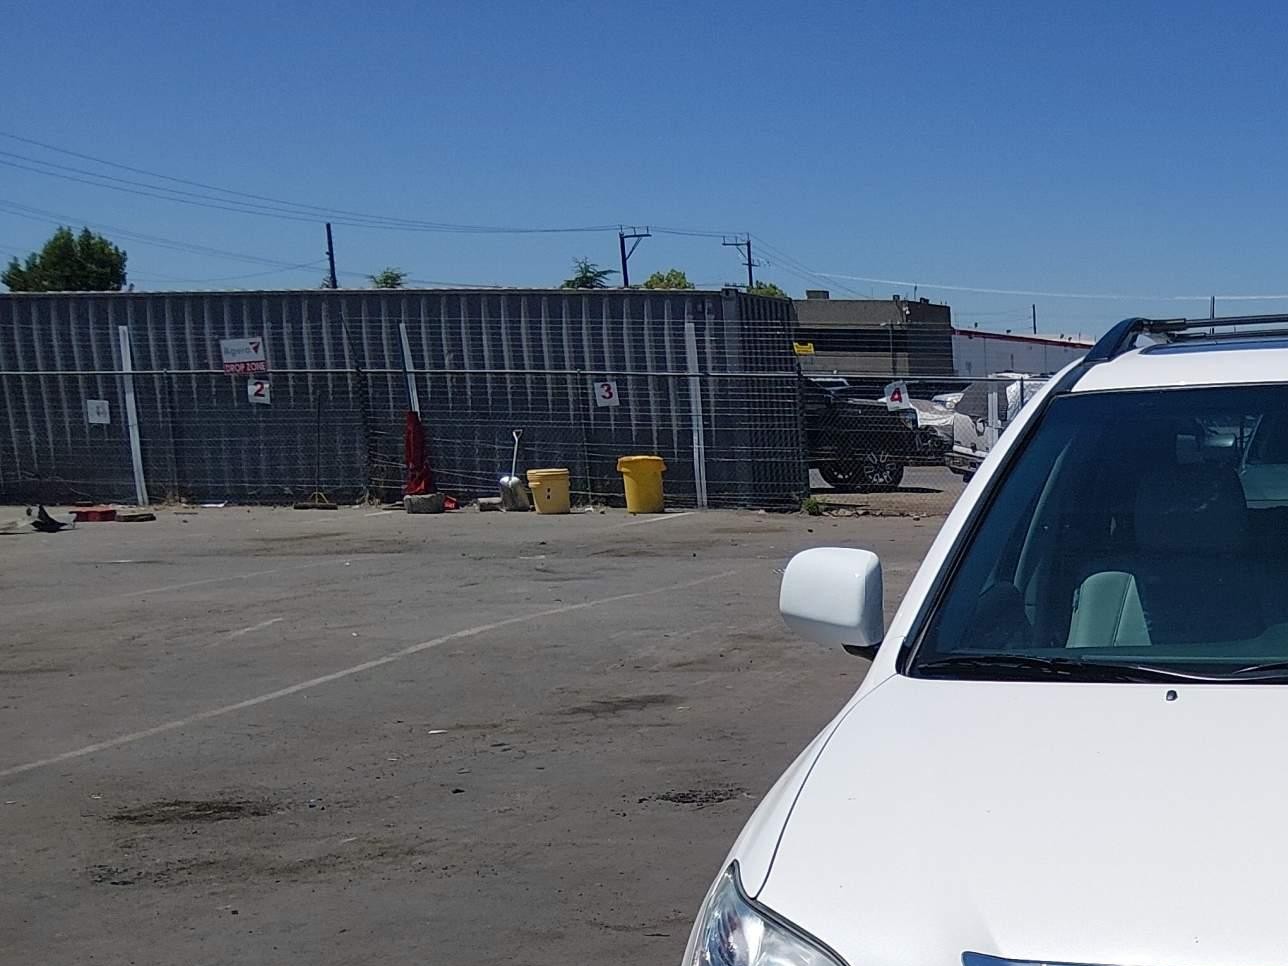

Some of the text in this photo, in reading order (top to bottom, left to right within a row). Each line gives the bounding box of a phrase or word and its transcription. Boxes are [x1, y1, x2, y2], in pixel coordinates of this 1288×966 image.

[225, 362, 266, 373] DROP ZONE
[254, 381, 265, 397] 2
[601, 383, 613, 399] 3
[890, 387, 903, 403] 4
